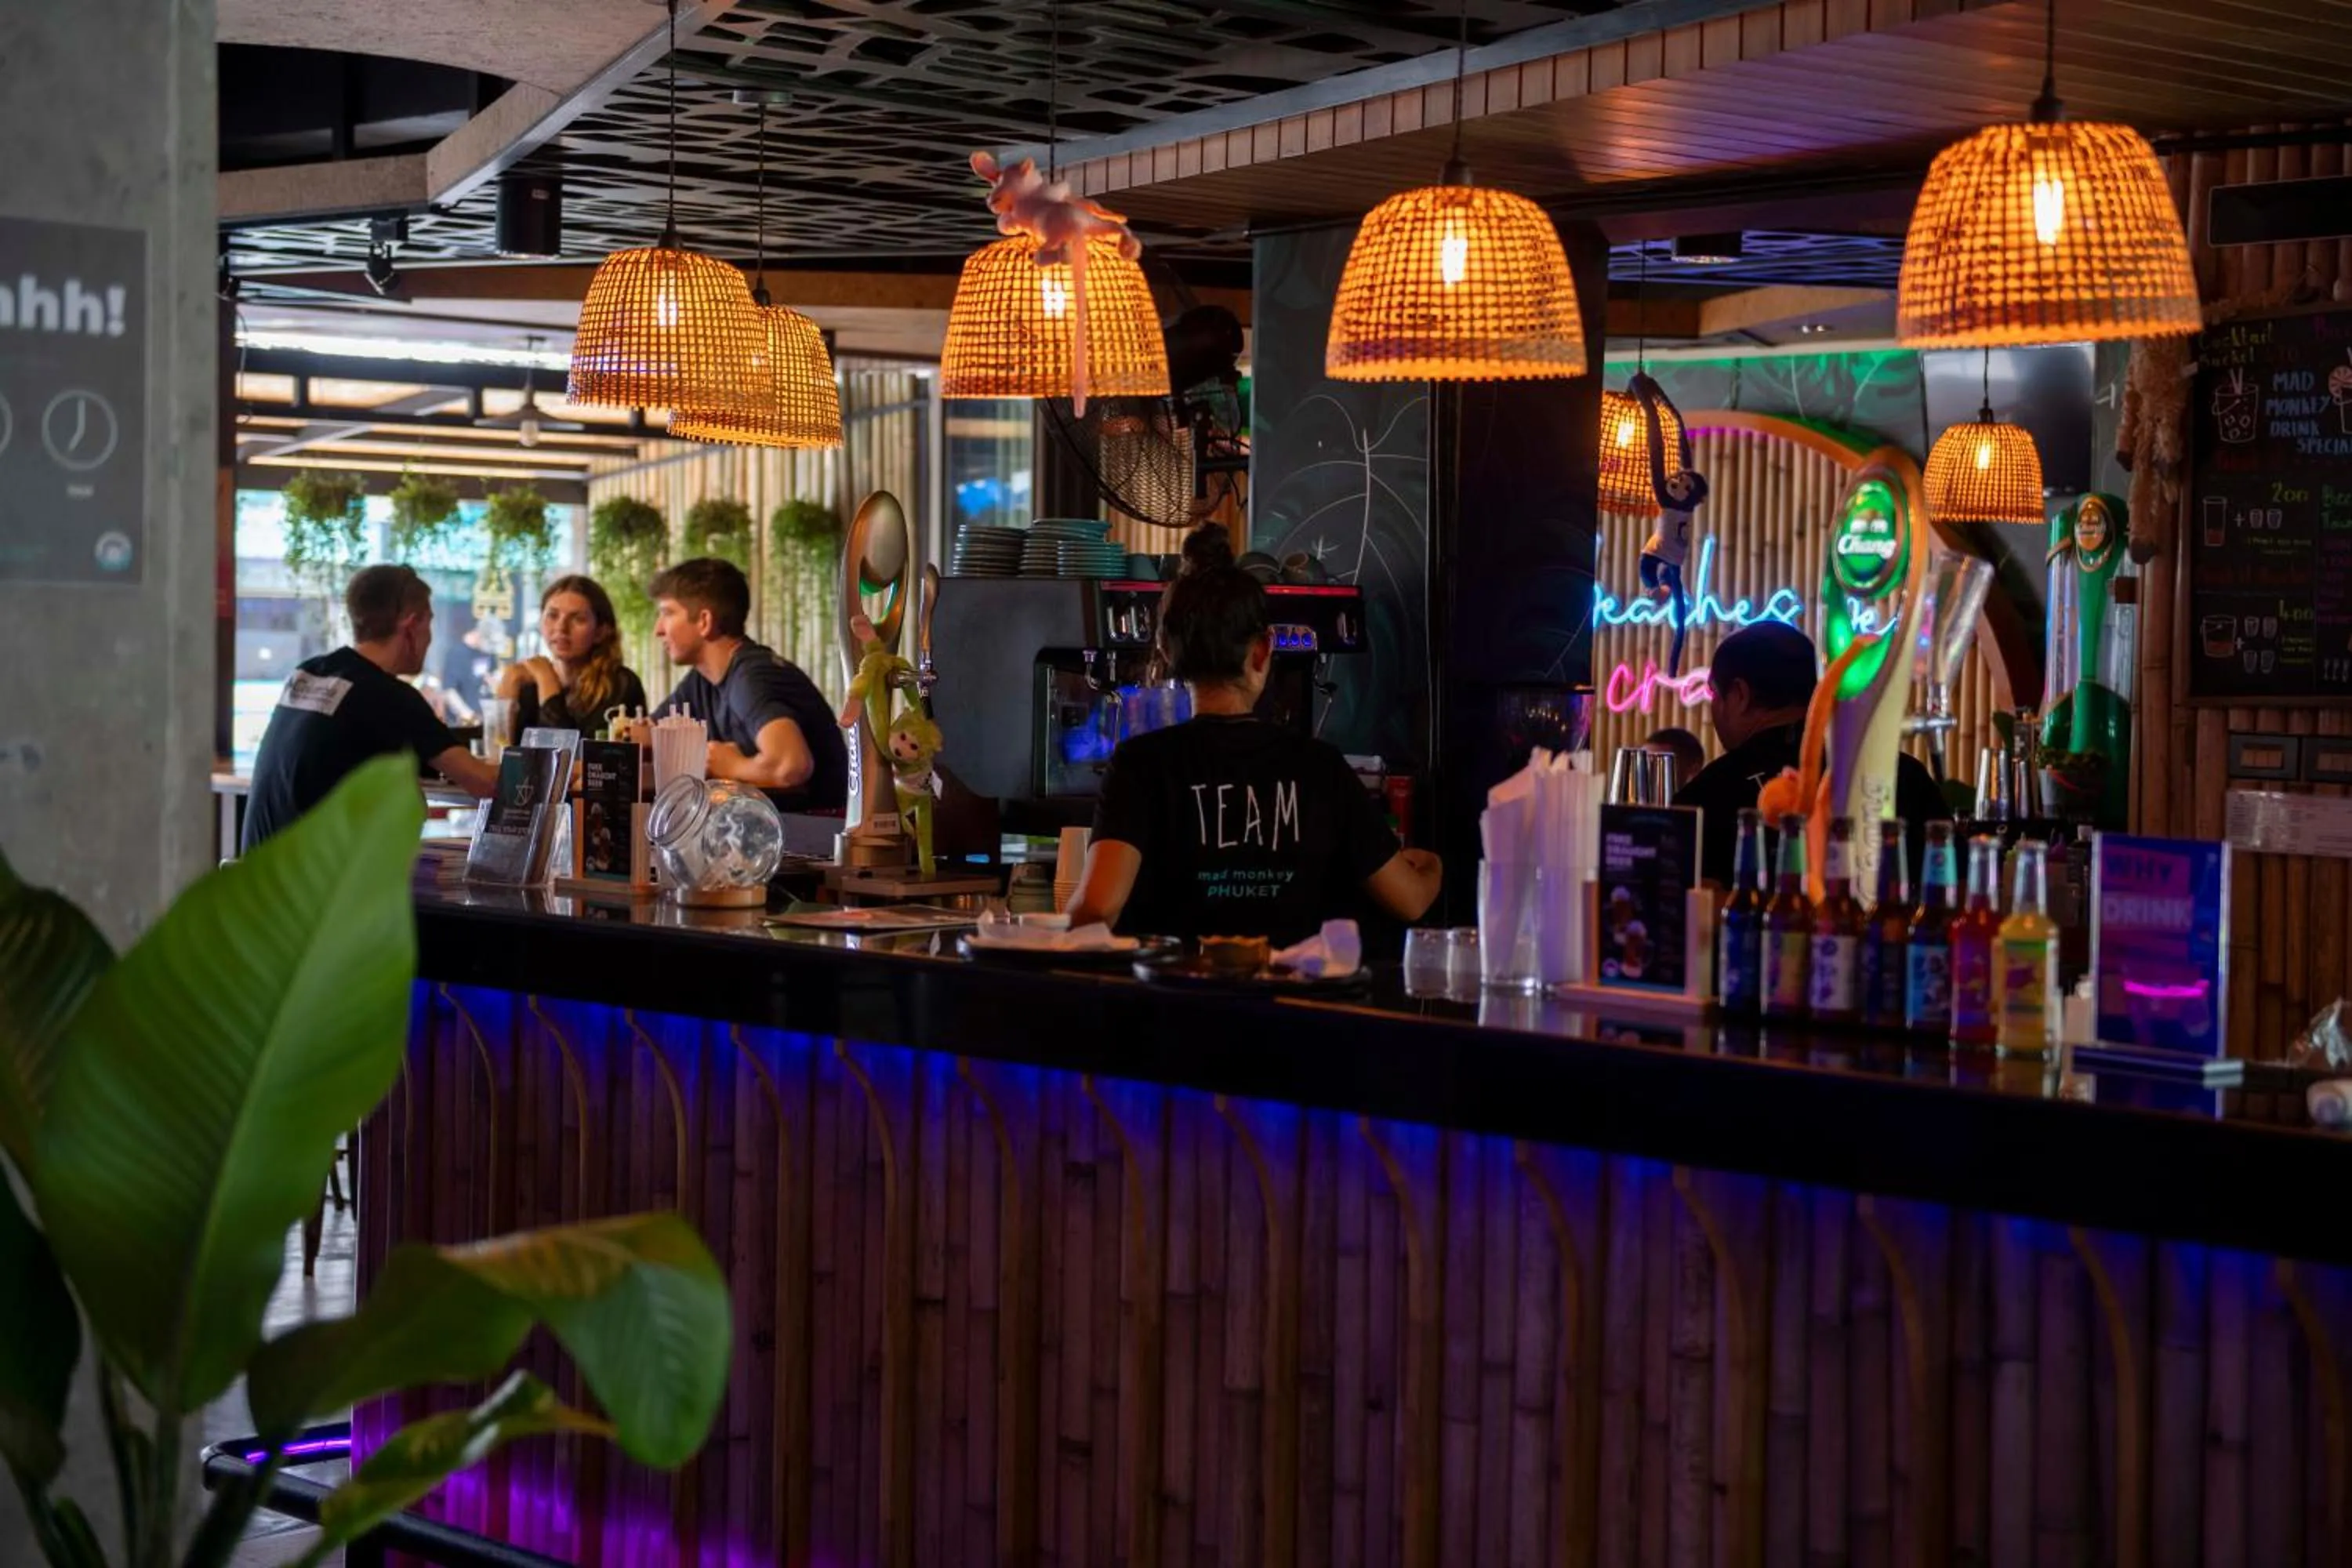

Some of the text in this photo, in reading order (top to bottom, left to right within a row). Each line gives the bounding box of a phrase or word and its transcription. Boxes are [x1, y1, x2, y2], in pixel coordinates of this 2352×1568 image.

[2272, 371, 2315, 392] MAD
[2265, 395, 2332, 416] MONKEY
[2270, 418, 2321, 437] DRINK
[1838, 534, 1896, 559] Chang
[1606, 662, 1714, 714] cra
[847, 721, 861, 797] Chan
[1190, 779, 1301, 851] TEAM
[1198, 868, 1294, 883] mad monkey
[1207, 884, 1281, 898] PHUKET
